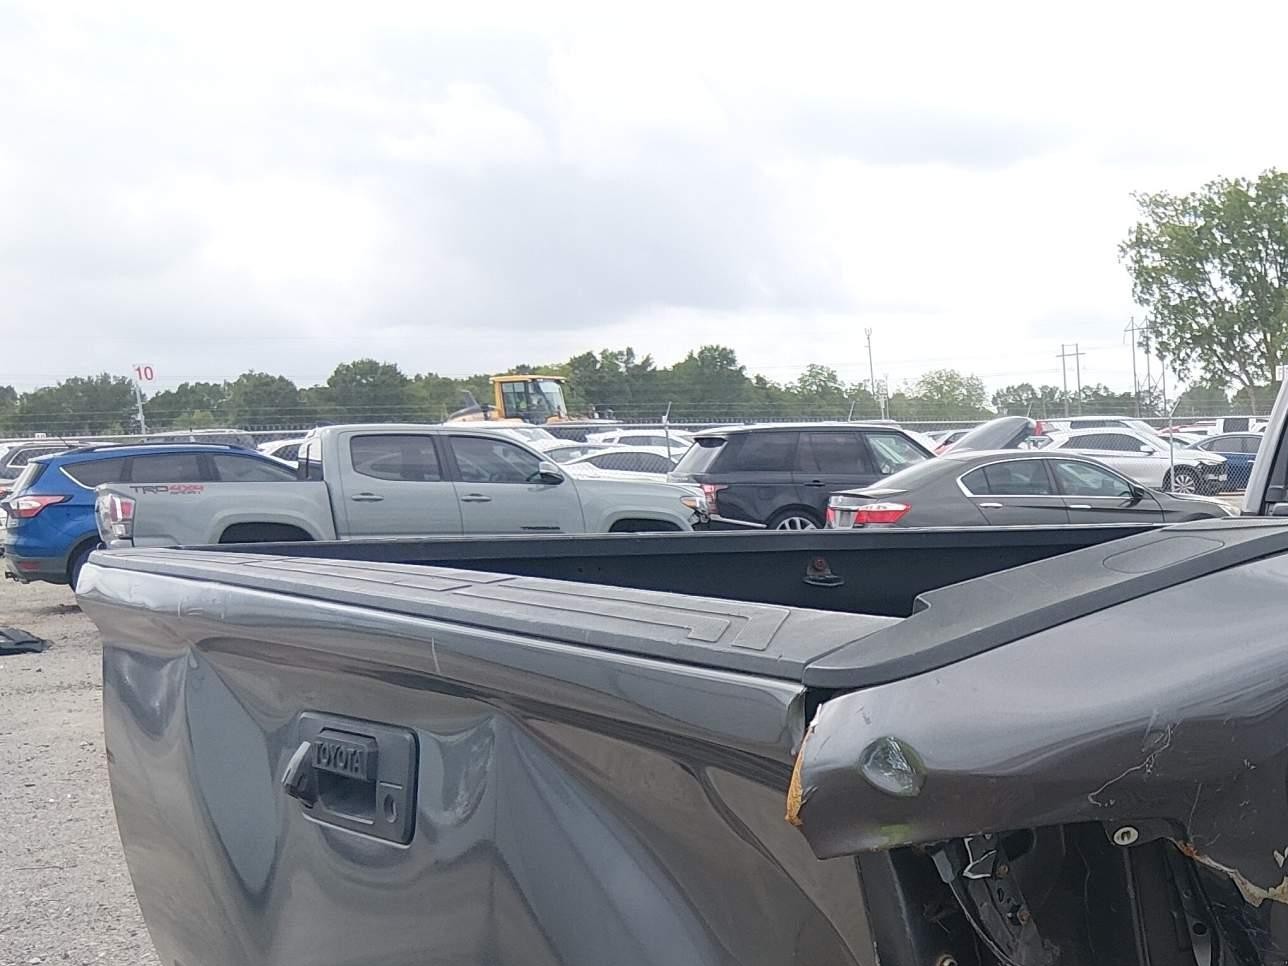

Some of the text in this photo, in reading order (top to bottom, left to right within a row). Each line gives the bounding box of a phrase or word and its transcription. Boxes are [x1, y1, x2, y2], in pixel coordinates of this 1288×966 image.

[135, 366, 154, 381] 10
[129, 485, 168, 495] TRD
[312, 740, 364, 775] TOYOTA
